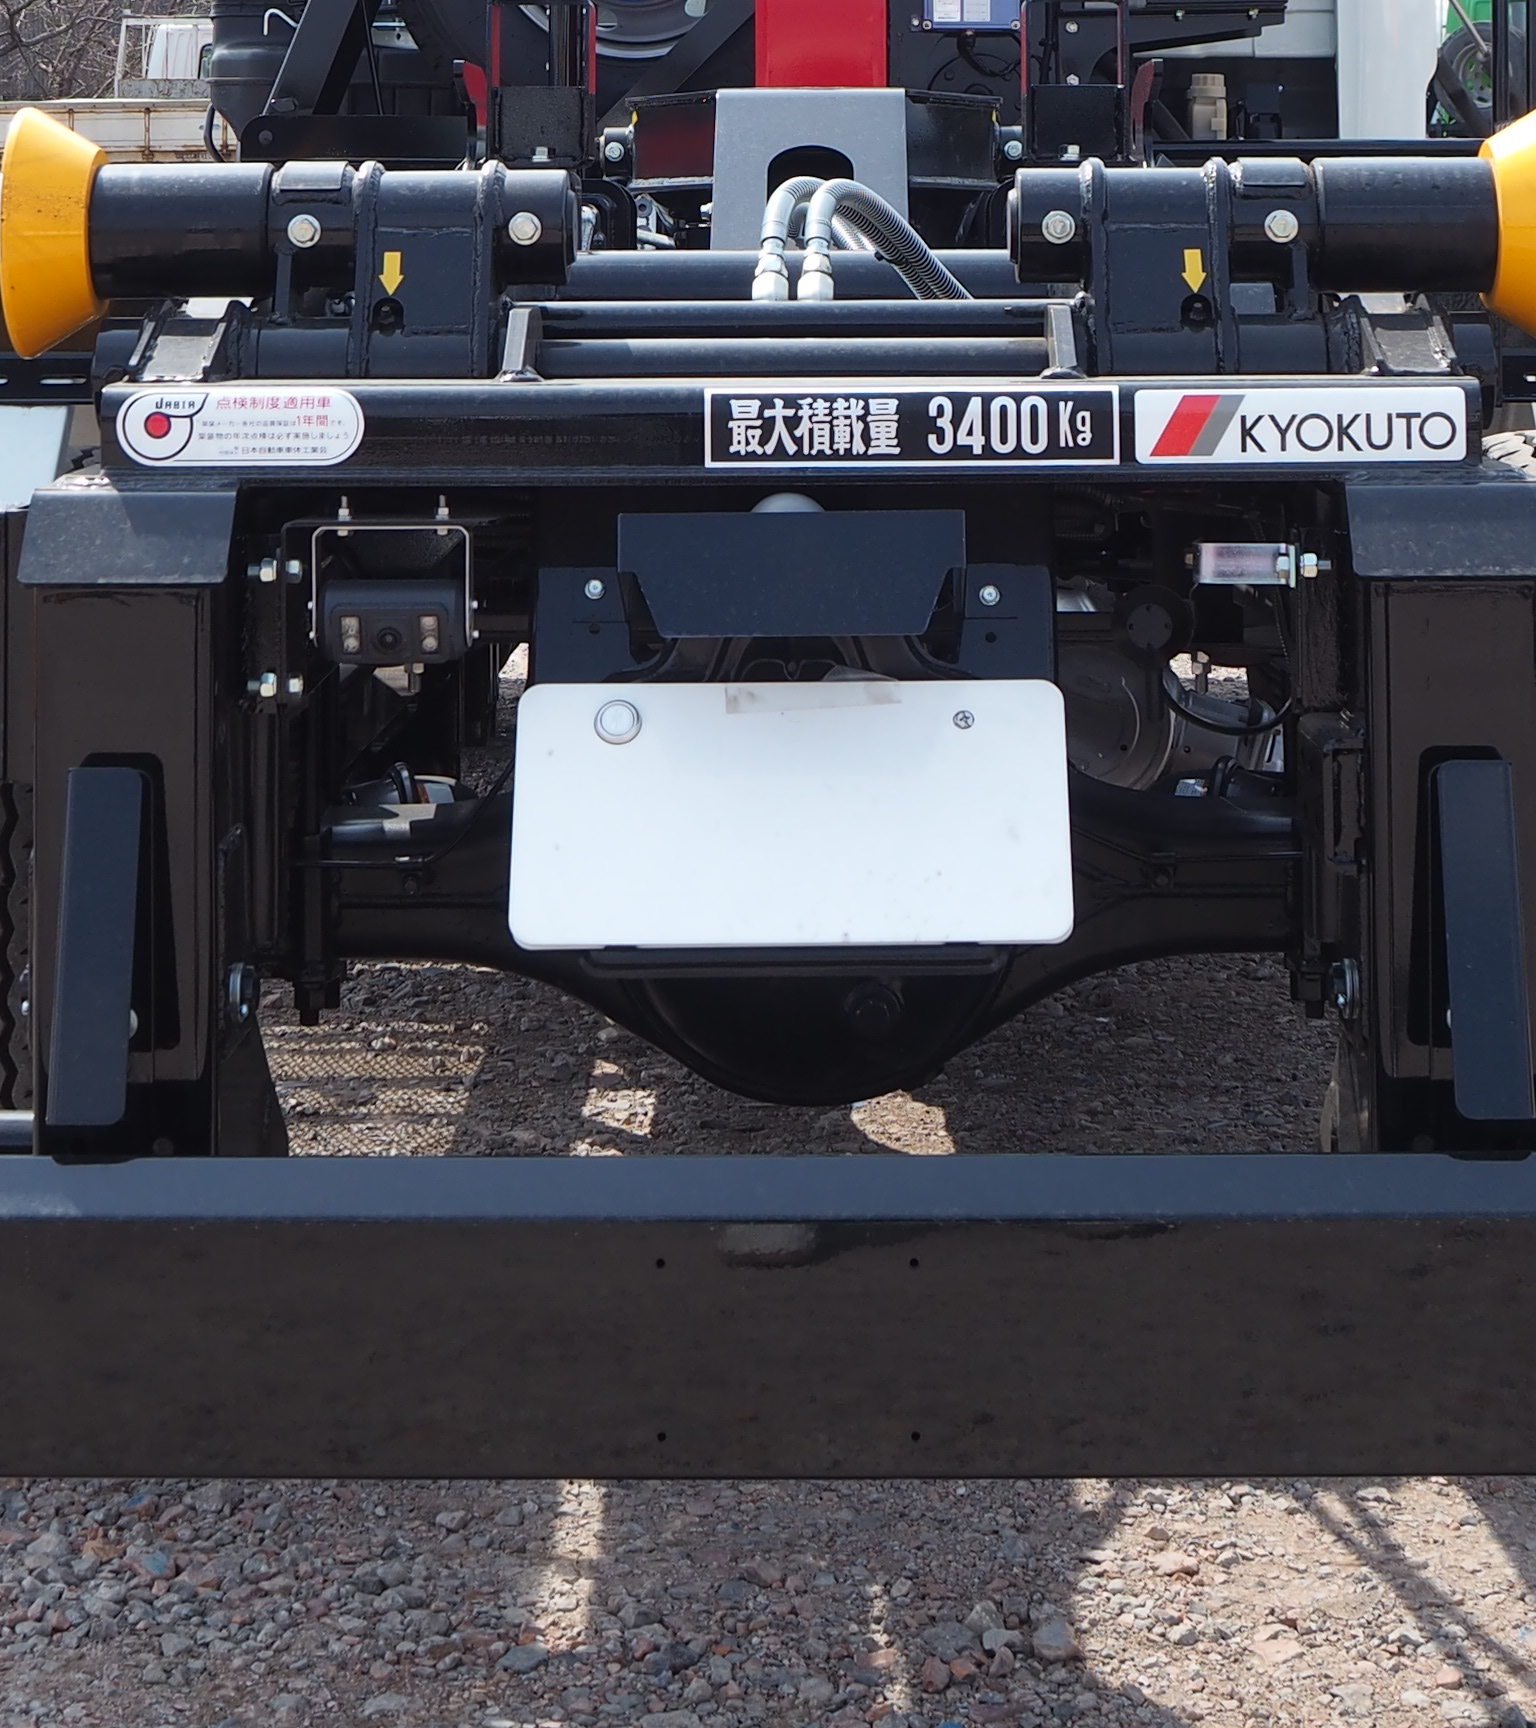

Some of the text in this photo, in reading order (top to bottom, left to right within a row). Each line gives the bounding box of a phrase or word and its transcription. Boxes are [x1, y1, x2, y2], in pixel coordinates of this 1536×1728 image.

[155, 397, 196, 410] JABIA
[216, 395, 332, 410] 点検制度適用車
[727, 397, 901, 457] 最大積載量
[1240, 411, 1457, 454] KYOKUTO
